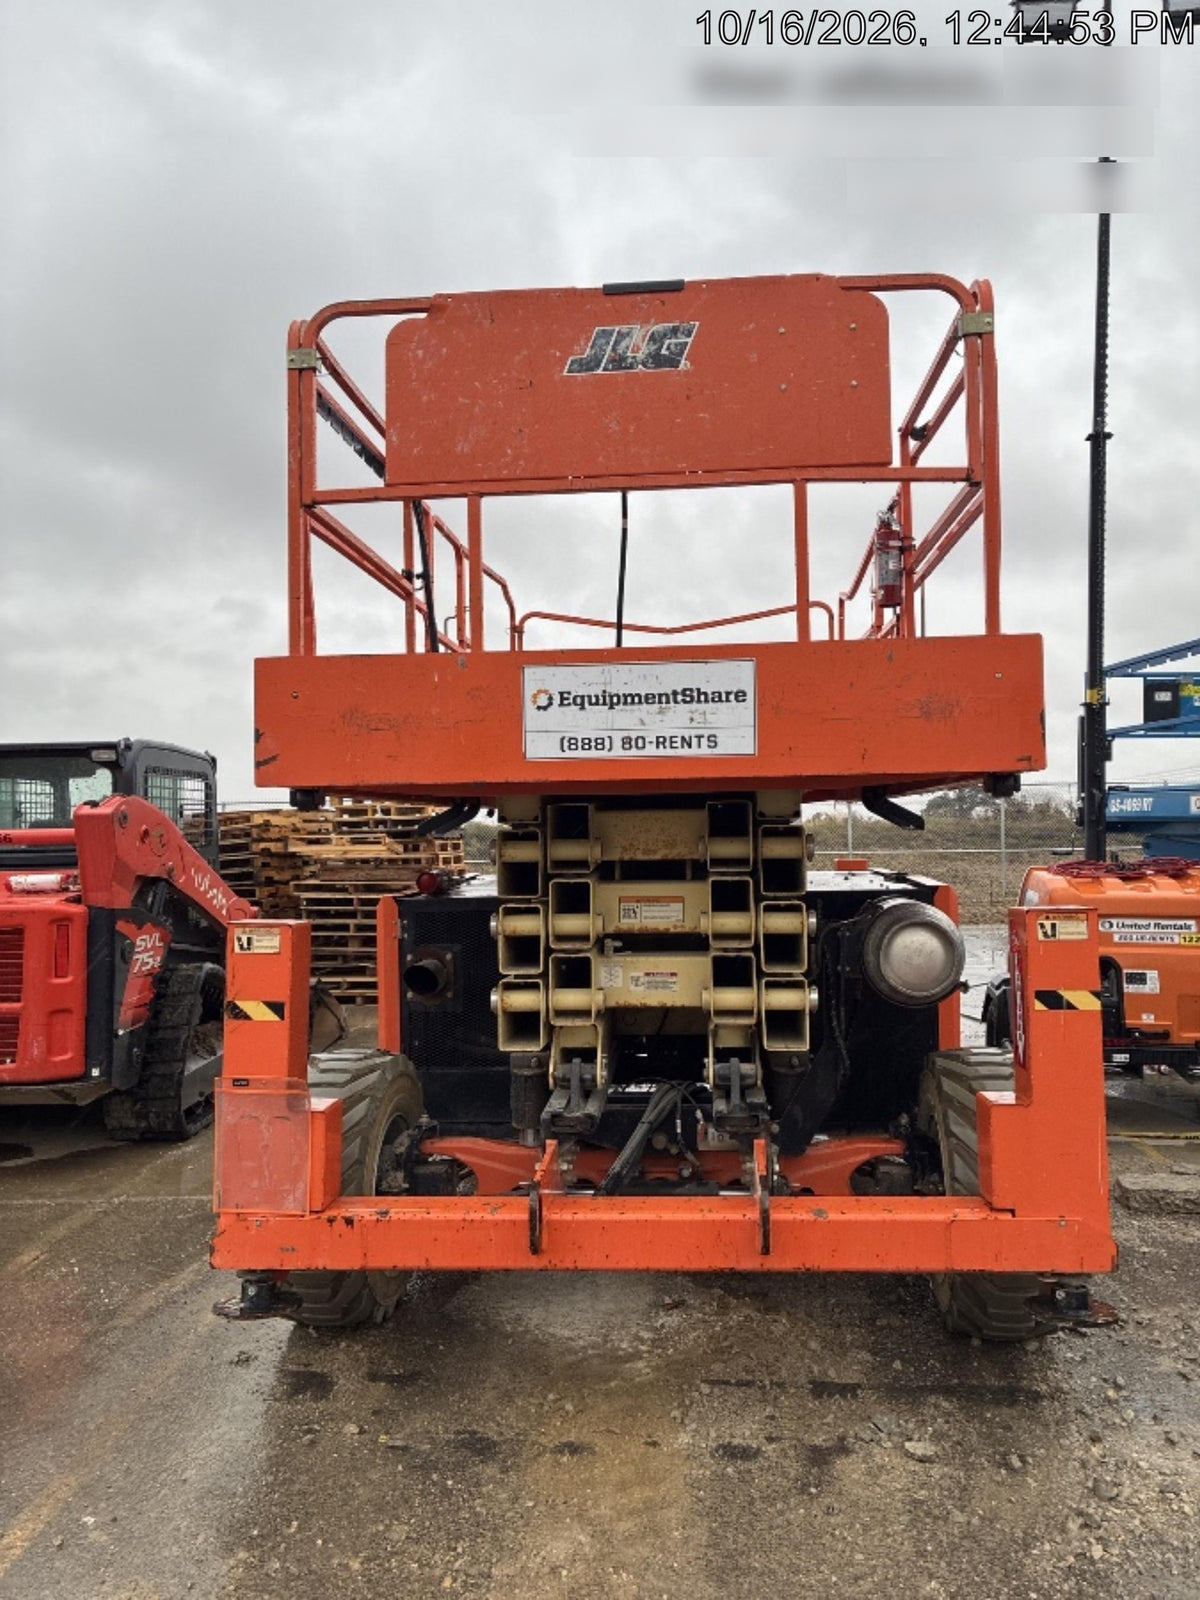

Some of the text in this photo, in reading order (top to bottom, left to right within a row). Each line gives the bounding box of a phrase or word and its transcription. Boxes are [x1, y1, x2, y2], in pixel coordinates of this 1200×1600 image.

[563, 321, 700, 375] JLG
[557, 686, 748, 711] EquipmentShare
[559, 734, 719, 752] (888) 80-RENTS
[135, 932, 164, 951] SVL
